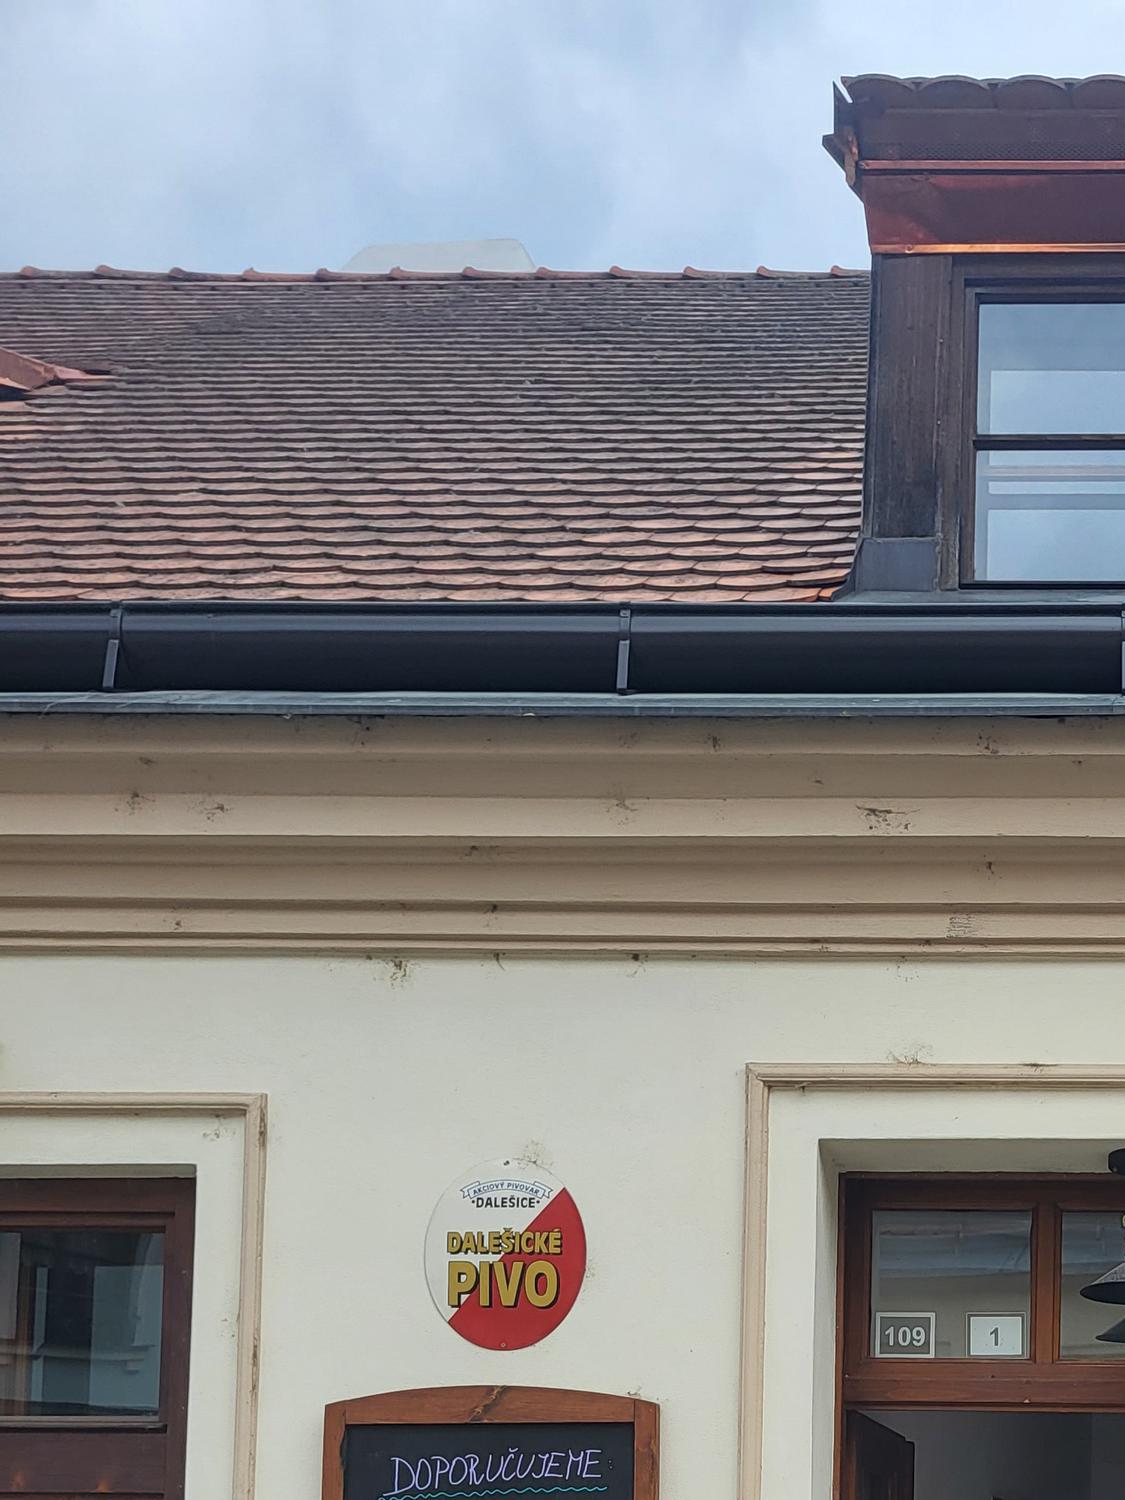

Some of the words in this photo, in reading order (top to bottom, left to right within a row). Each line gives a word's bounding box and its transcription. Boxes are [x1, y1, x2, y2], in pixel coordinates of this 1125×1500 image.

[473, 1181, 504, 1196] AKCIOVÝ
[507, 1182, 540, 1196] PIVOVAR
[447, 1227, 562, 1255] DALEŠICKÉ
[447, 1260, 560, 1308] PIVO
[884, 1326, 926, 1347] 109
[989, 1327, 1000, 1347] 1
